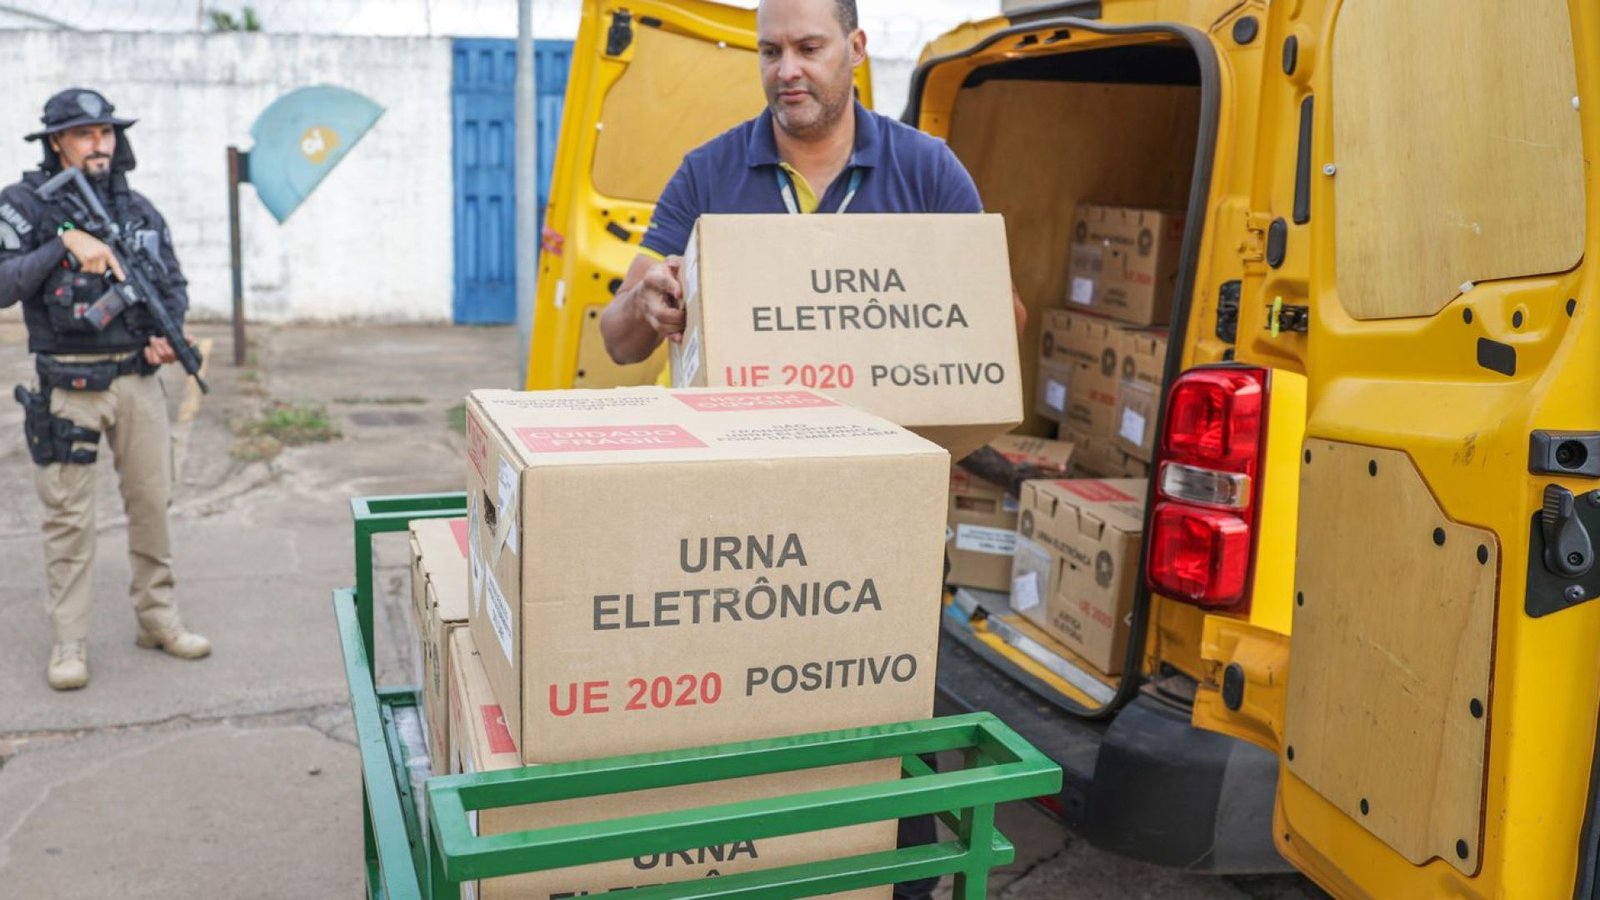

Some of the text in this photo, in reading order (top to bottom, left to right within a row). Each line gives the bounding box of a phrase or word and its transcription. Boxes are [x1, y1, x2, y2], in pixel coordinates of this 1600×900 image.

[811, 268, 906, 294] URNA
[752, 298, 969, 331] ELETRÔNICA
[782, 363, 855, 389] 2020
[529, 429, 678, 440] CUIDADO
[680, 533, 808, 573] URNA
[593, 576, 882, 631] ELETRÔNICA
[745, 653, 917, 697] POSITIVO
[549, 672, 722, 717] UE 2020
